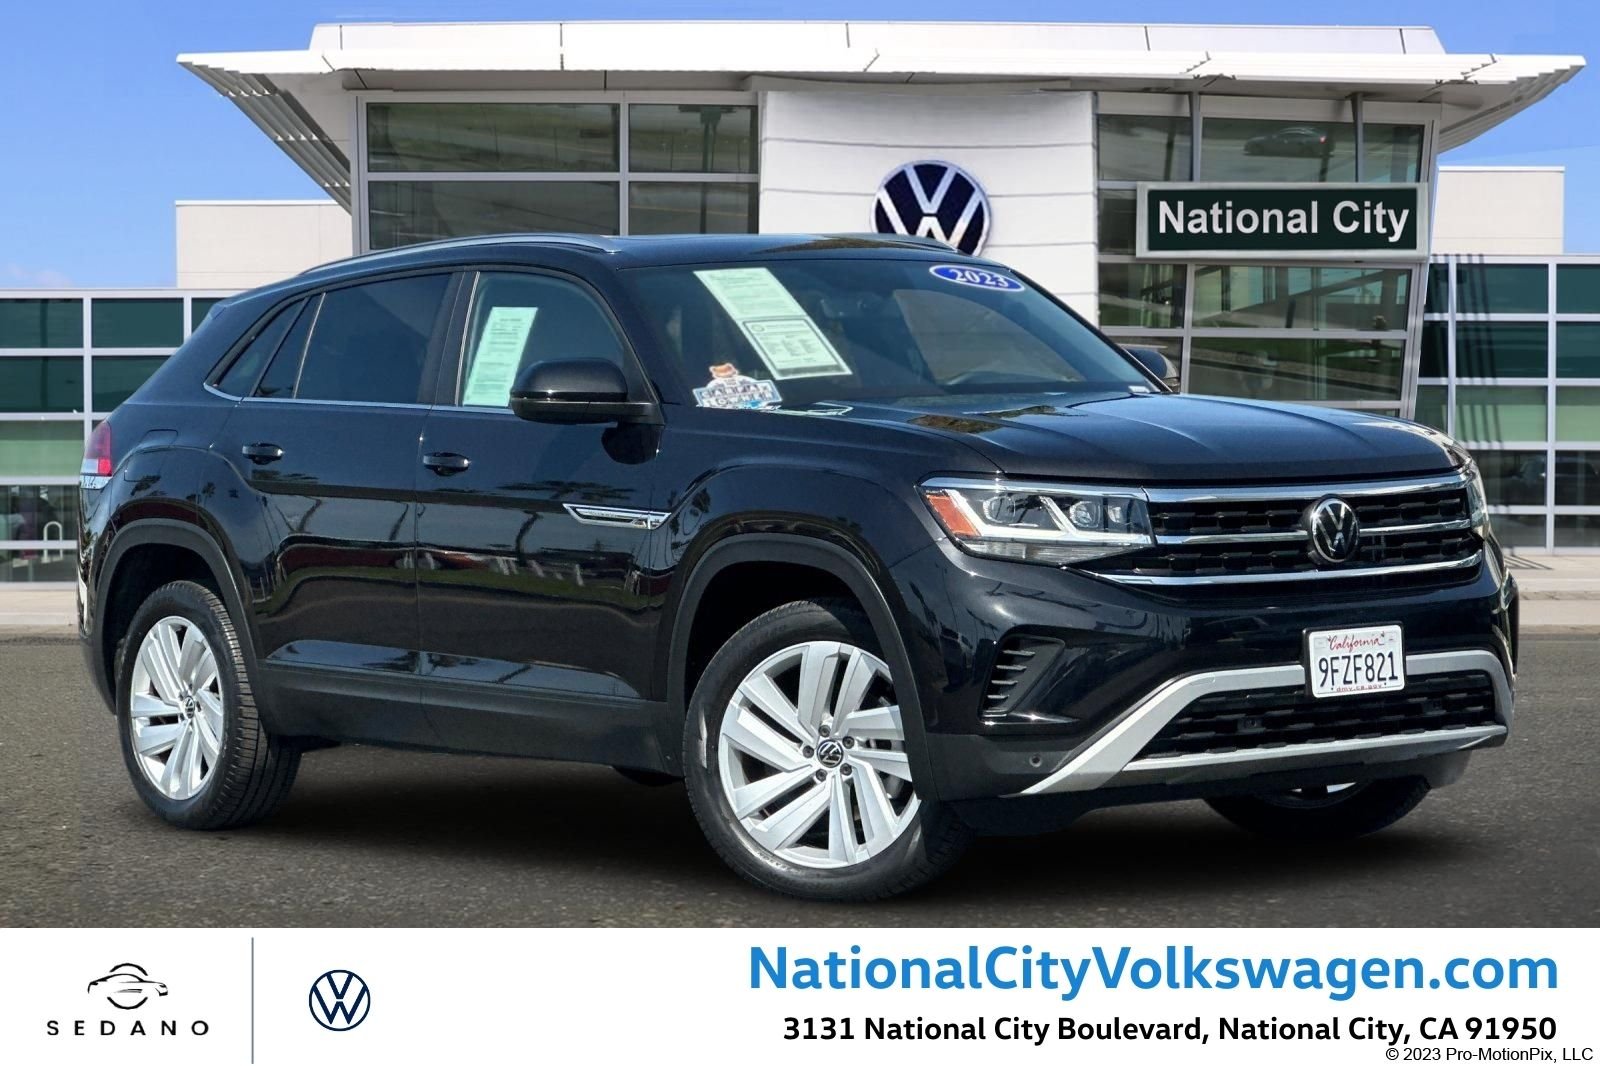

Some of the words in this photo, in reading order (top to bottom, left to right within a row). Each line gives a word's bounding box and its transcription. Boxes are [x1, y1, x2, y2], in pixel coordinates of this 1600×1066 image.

[1159, 200, 1318, 235] National
[1332, 200, 1409, 243] City
[949, 269, 1009, 288] 2023
[1329, 633, 1384, 653] California
[1318, 651, 1398, 688] 9FZF821
